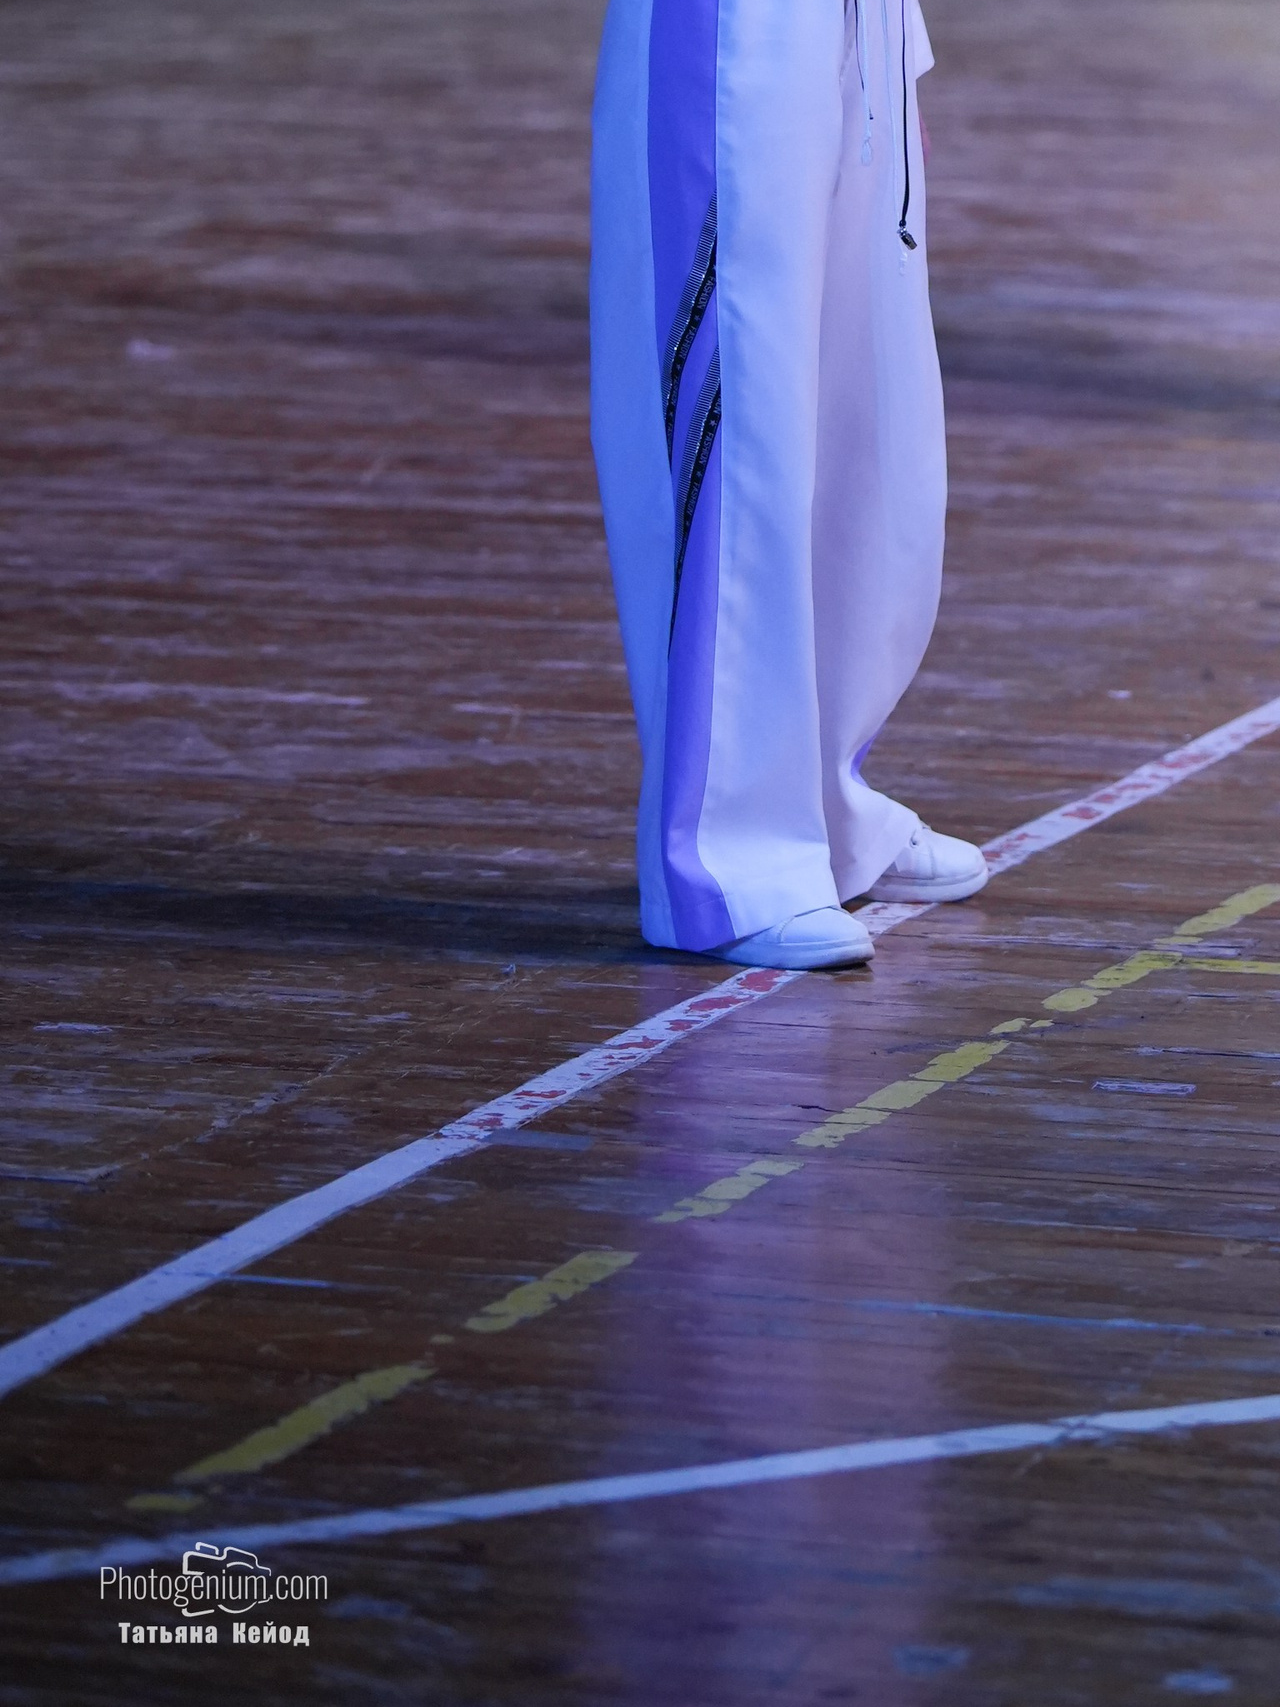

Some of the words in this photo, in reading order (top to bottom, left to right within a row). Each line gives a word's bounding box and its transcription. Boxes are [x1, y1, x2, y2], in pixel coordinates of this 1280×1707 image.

[697, 276, 716, 310] FASHION
[679, 325, 697, 359] FASHION
[699, 432, 715, 465] FASHION
